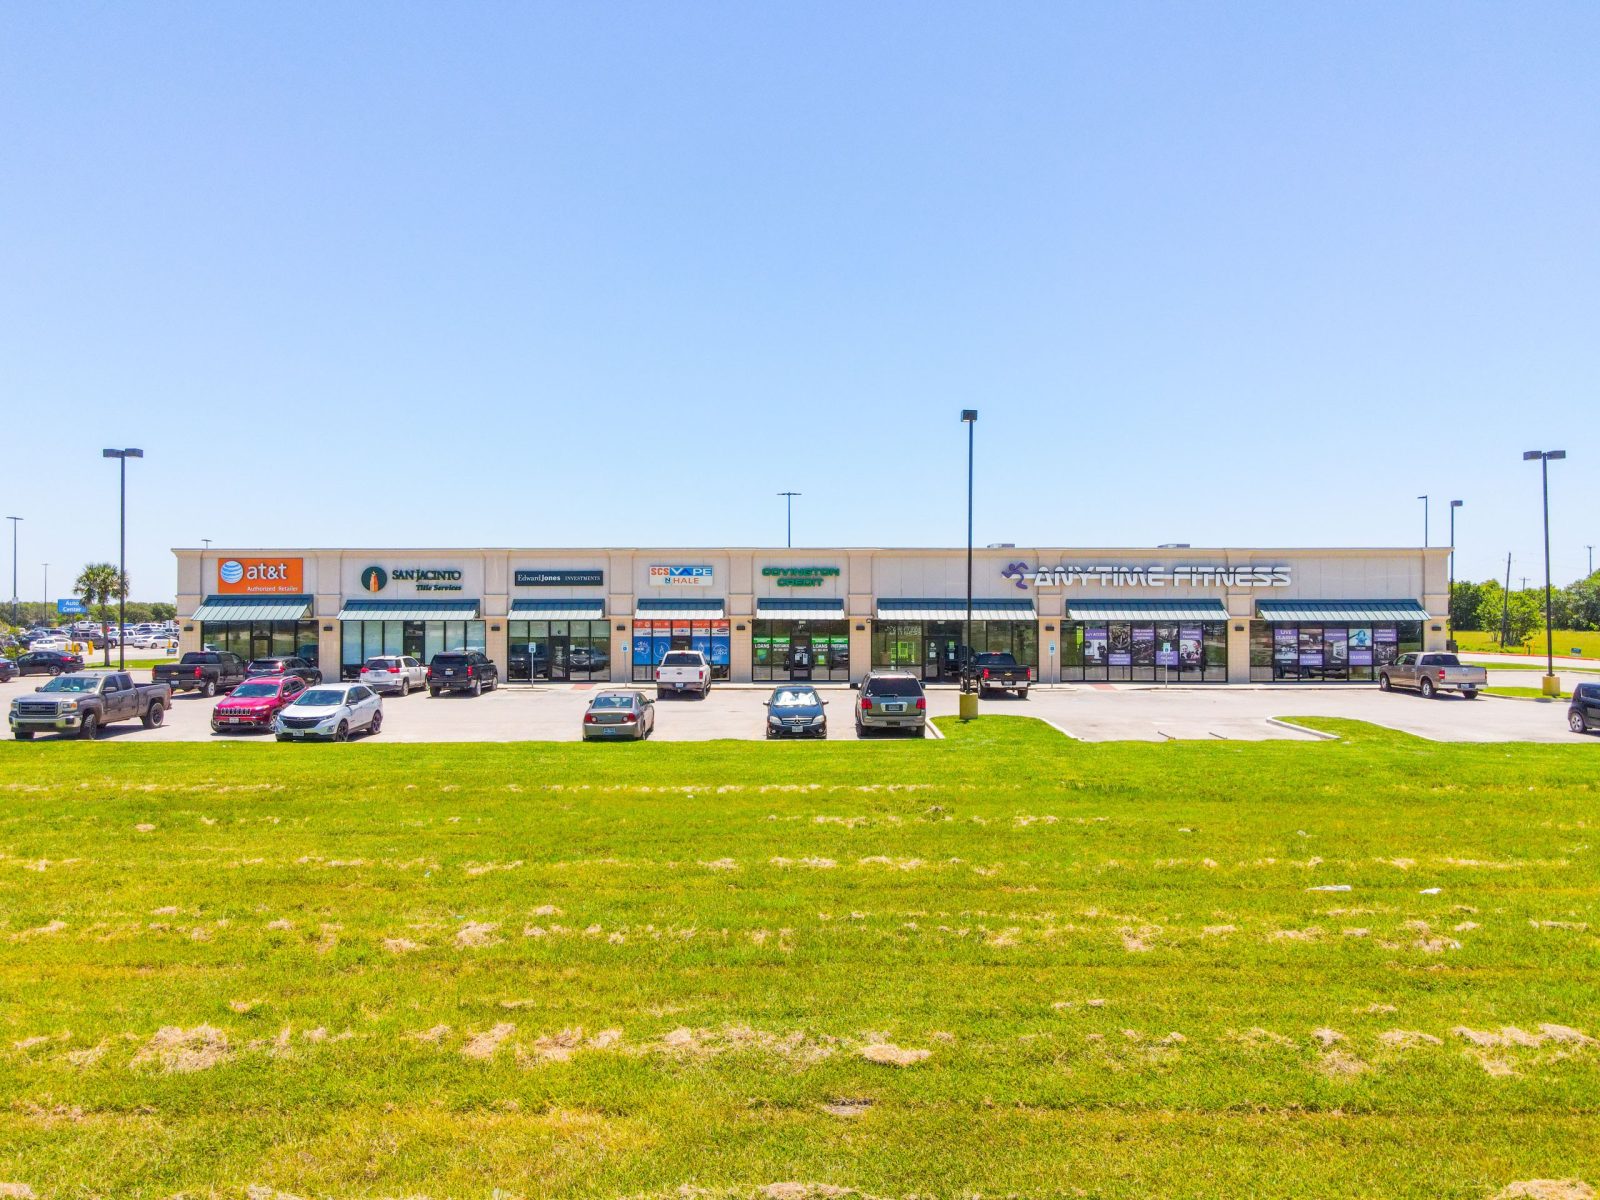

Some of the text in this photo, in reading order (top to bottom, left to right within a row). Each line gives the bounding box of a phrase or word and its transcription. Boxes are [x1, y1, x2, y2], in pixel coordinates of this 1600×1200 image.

[246, 562, 288, 580] at&t
[392, 569, 462, 582] SAN JACINTO
[651, 567, 712, 576] SCS VAPE
[761, 567, 840, 577] COVINGTON
[541, 574, 561, 582] Jones
[1033, 566, 1292, 587] ANYTIME FITNESS
[776, 577, 824, 587] CREDIT
